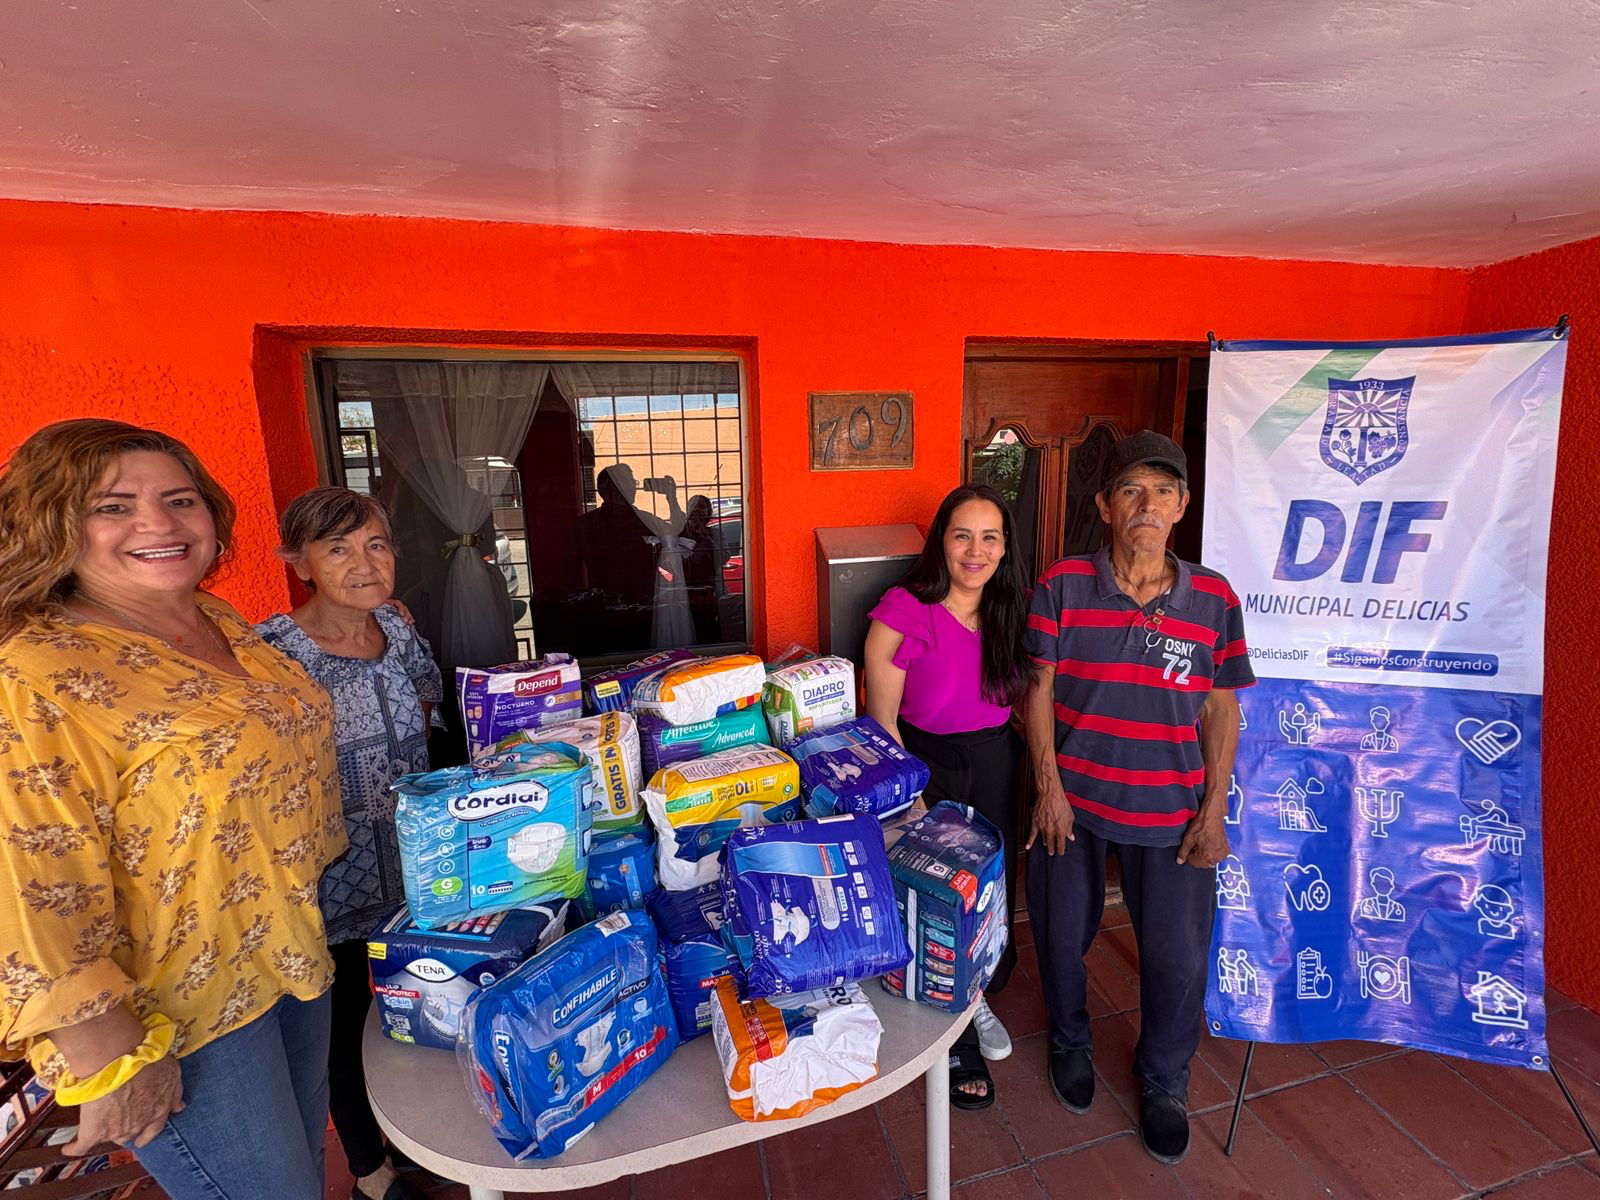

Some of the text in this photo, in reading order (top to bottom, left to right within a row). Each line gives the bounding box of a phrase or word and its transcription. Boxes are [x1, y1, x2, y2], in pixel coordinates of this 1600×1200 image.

[1358, 380, 1385, 390] 1933
[1397, 388, 1410, 453] CONSTANCIA
[817, 397, 907, 466] 709
[1336, 462, 1386, 483] LEALTAD
[1272, 499, 1449, 585] DIF
[1245, 593, 1471, 622] MUNICIPAL DELICIAS
[1164, 638, 1197, 657] OSNY
[1247, 647, 1309, 661] @DeliciasDIF
[1162, 652, 1193, 686] 72
[1334, 651, 1493, 673] #SigamosConstruyendo
[517, 674, 558, 692] Depend
[802, 680, 845, 701] DIAPRO
[496, 699, 536, 711] NOCTURNO
[711, 722, 756, 748] Advanced
[781, 720, 789, 742] DIAP
[608, 764, 627, 810] GRATIS
[440, 878, 453, 889] G
[470, 884, 486, 895] 10
[415, 964, 446, 976] TENA
[552, 968, 617, 1024] CONFIHABILE
[617, 980, 648, 998] ACTIVO
[634, 1049, 647, 1061] 10
[592, 1081, 602, 1097] M
